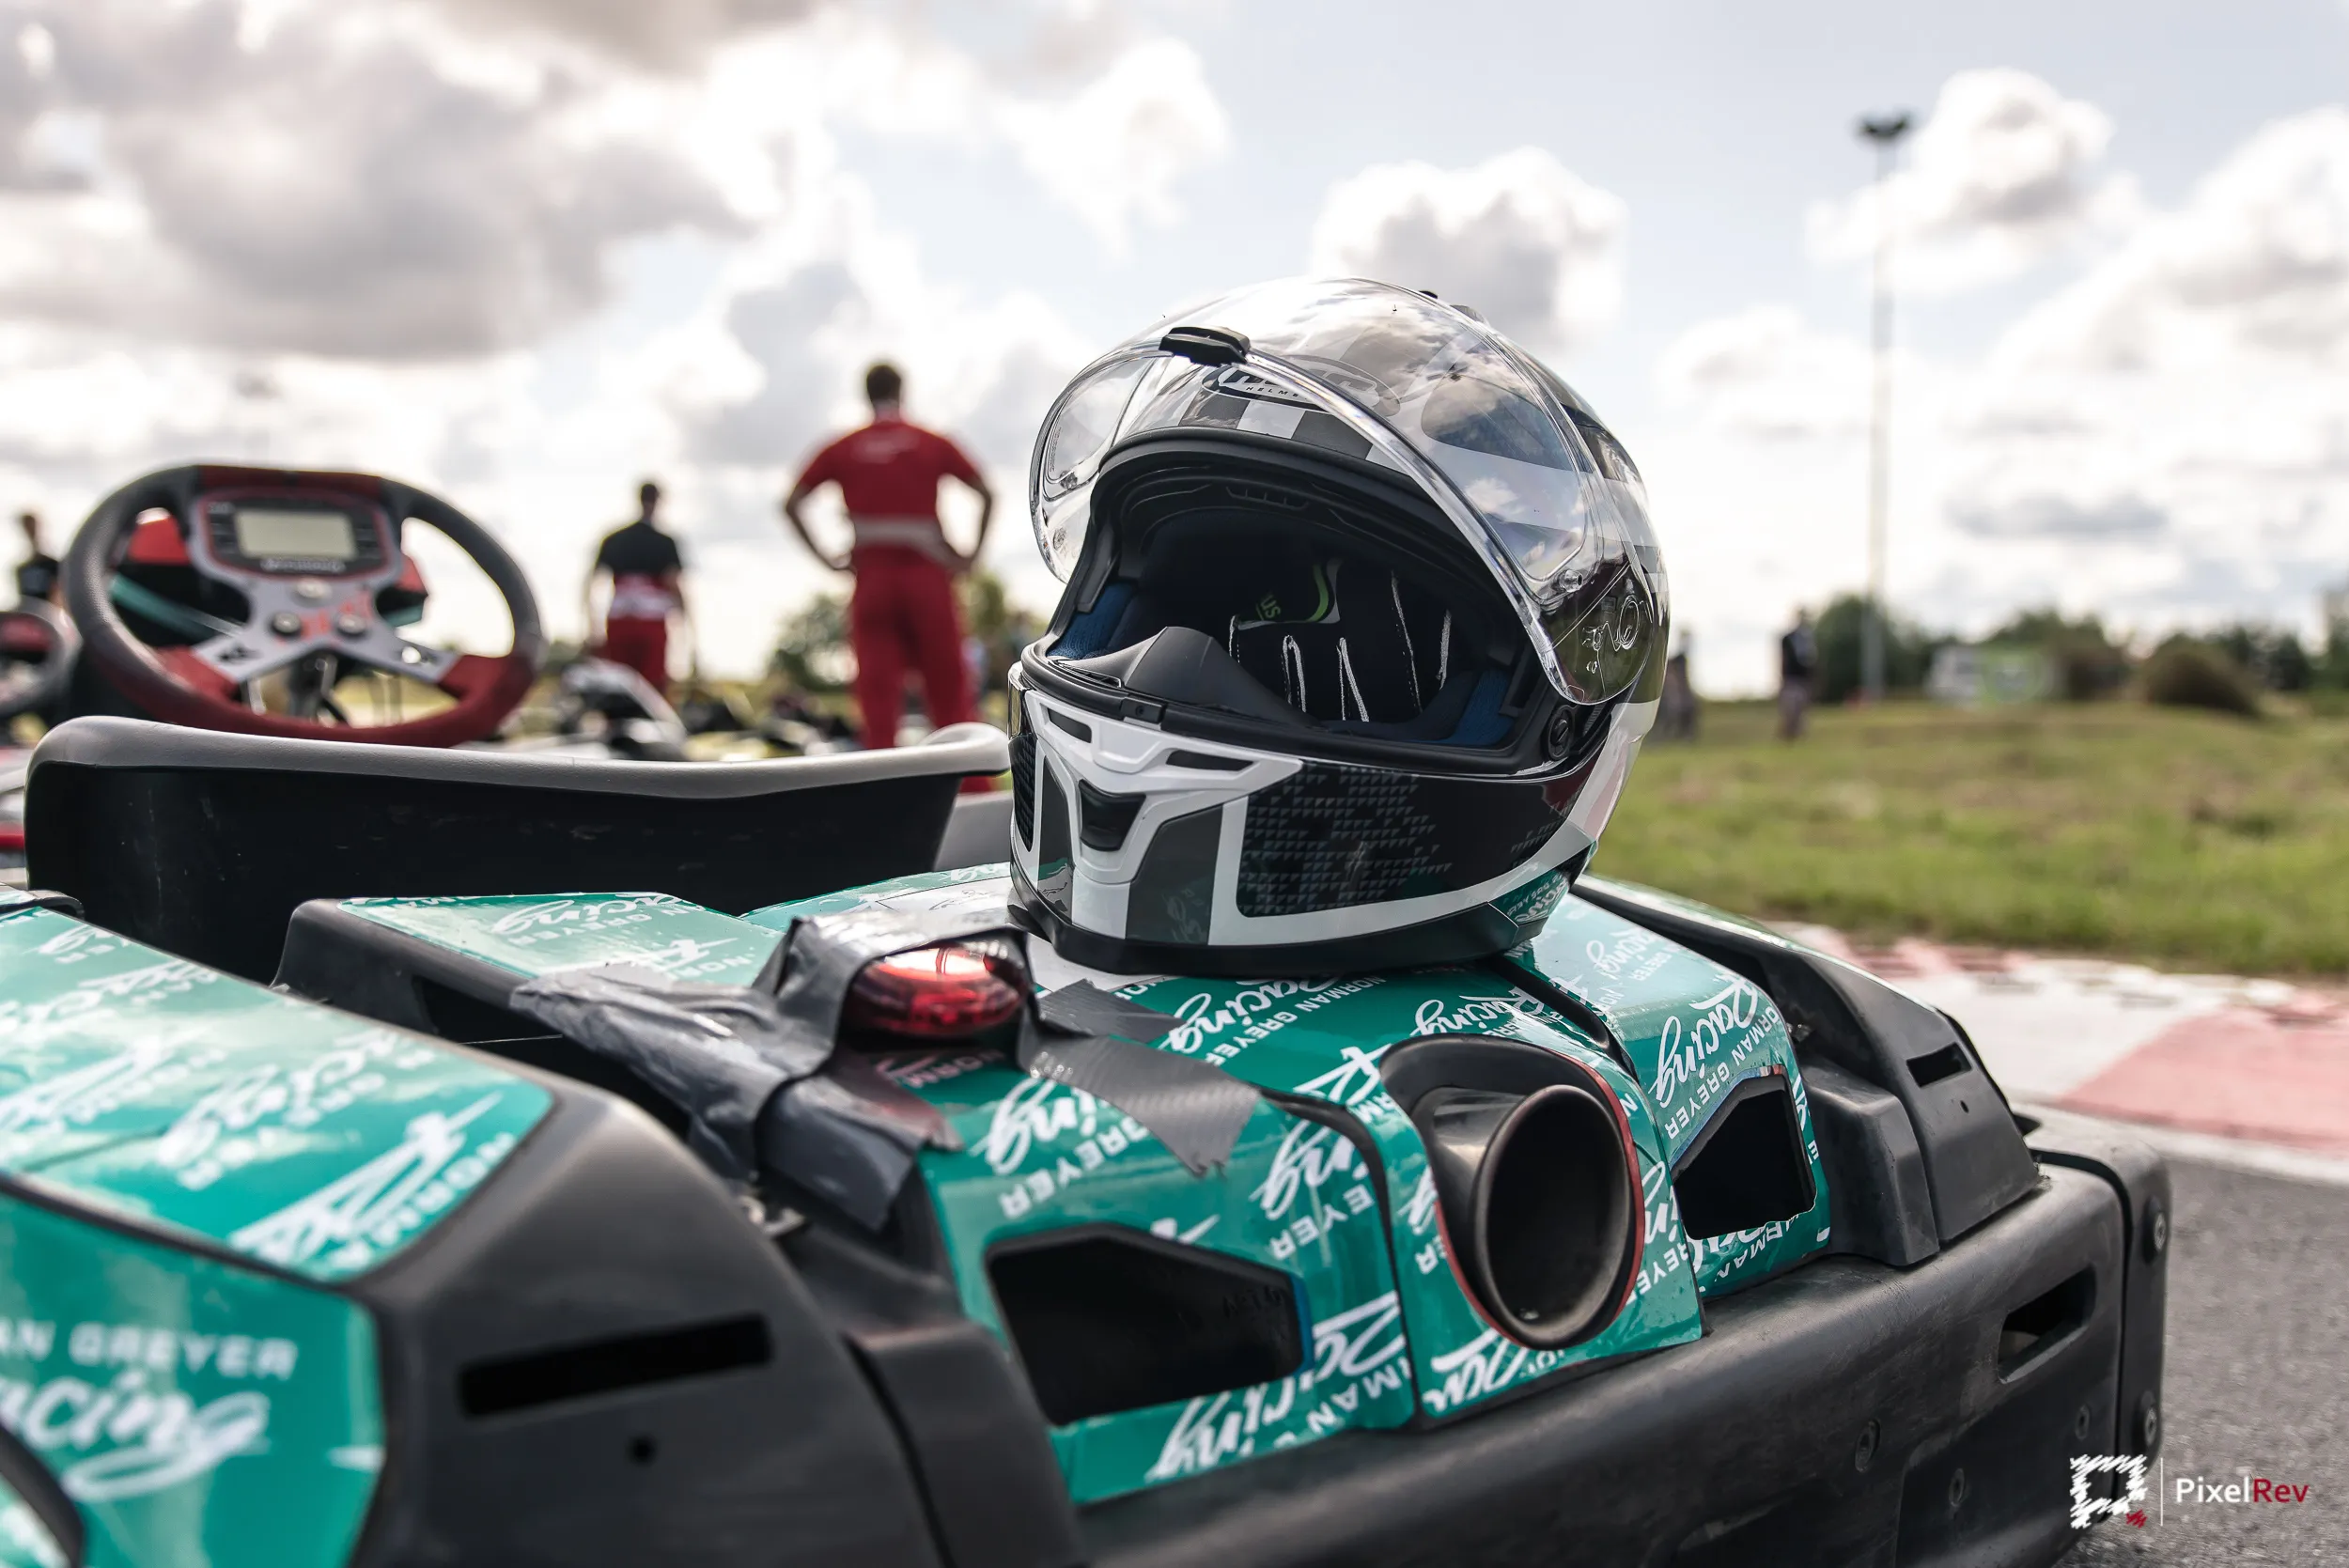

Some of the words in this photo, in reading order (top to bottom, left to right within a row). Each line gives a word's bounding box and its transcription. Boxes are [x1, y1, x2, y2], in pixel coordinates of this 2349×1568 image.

[1246, 385, 1308, 401] HELME
[1294, 976, 1388, 1013] NORMAN
[1205, 1012, 1299, 1066] GREYER
[1648, 970, 1758, 1109] Racing
[1731, 1005, 1780, 1067] ORMAN
[1664, 1061, 1731, 1140] GREYER
[997, 1115, 1151, 1219] GREYER
[1268, 1184, 1376, 1261] EYER
[1714, 1215, 1798, 1282] RMAN
